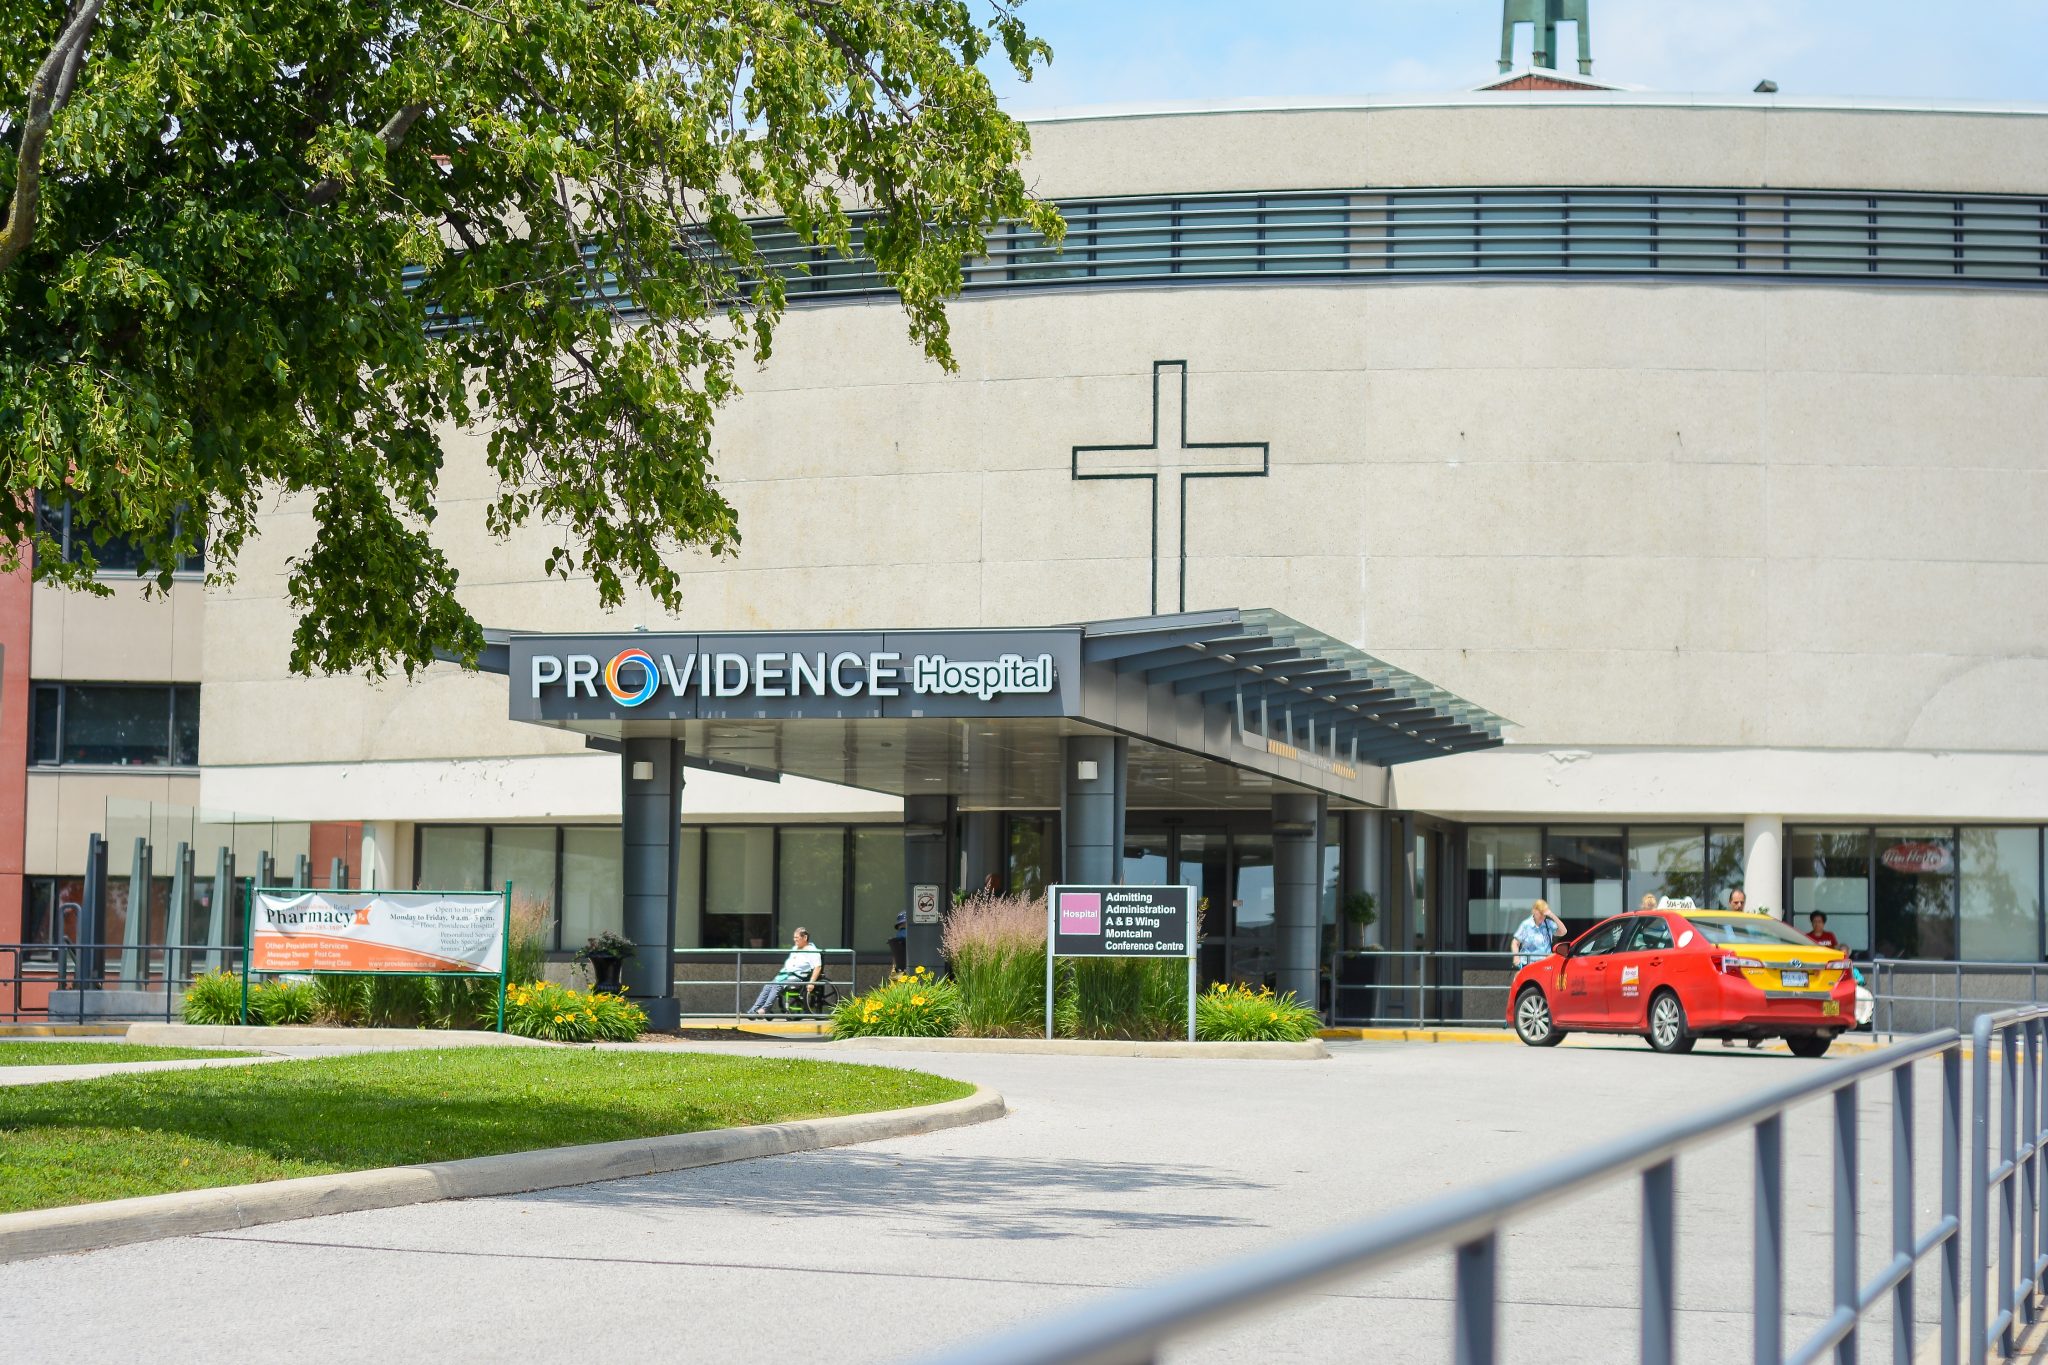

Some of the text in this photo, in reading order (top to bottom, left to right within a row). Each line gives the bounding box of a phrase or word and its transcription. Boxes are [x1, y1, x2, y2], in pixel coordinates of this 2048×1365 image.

[531, 647, 1053, 708] PROVIDENCE Hospital
[1105, 892, 1153, 904] Admitting
[1063, 909, 1098, 919] Hospital
[1105, 904, 1176, 914] Administration
[266, 908, 354, 928] Pharmacy
[390, 913, 416, 922] Monday
[426, 914, 448, 922] Friday,
[1105, 917, 1160, 928] A & B Wing
[470, 922, 495, 931] Hospital
[1105, 928, 1152, 938] Montcalm
[1105, 941, 1184, 951] Conference Centre
